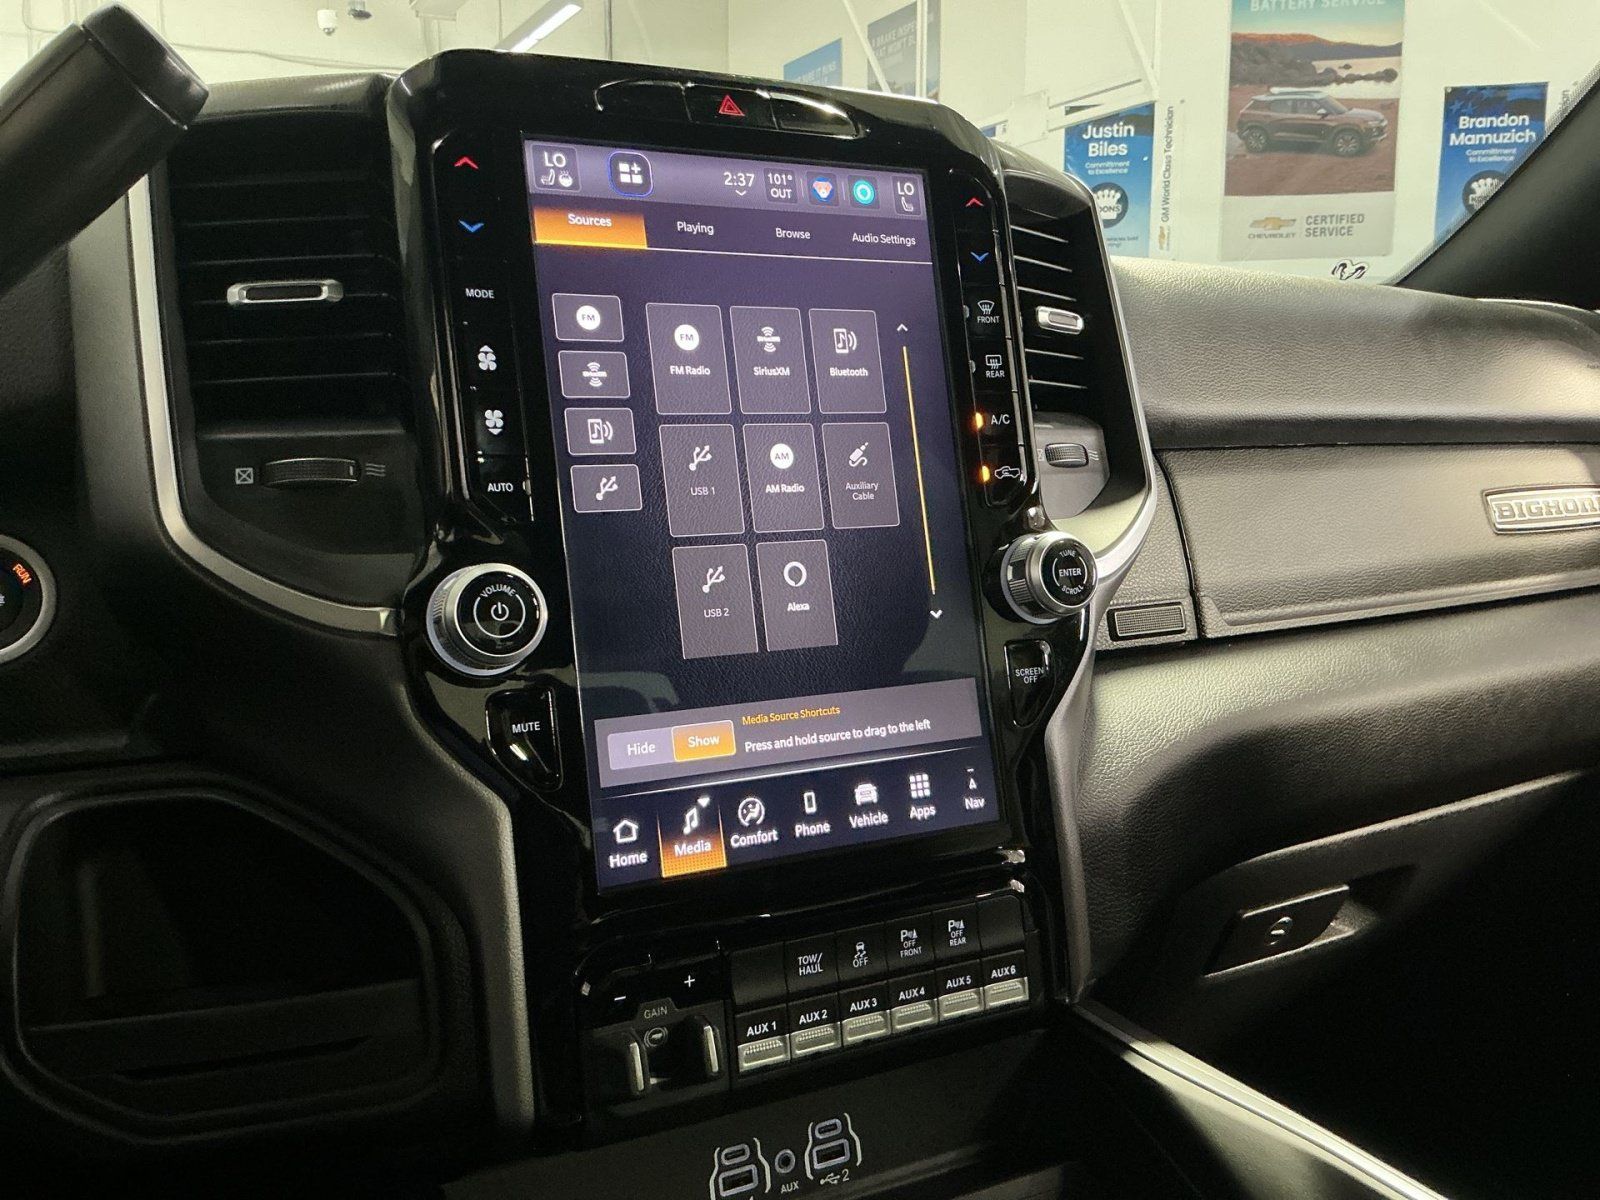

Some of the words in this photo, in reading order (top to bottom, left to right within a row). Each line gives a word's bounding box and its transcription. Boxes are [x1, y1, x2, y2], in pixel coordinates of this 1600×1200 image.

[1250, 0, 1316, 12] BATTERY
[1459, 112, 1530, 129] Brandon
[1082, 121, 1135, 139] Justin
[1164, 106, 1174, 153] Technician
[1449, 129, 1537, 146] Mamuzich
[1088, 141, 1128, 157] Biles
[1465, 148, 1517, 156] Commitment
[543, 152, 567, 168] LO
[1085, 161, 1130, 169] Commitment
[1163, 155, 1172, 180] Class
[723, 171, 755, 188] 2:37
[770, 187, 792, 199] OUT
[897, 181, 915, 196] LO
[1161, 180, 1170, 205] World
[1160, 204, 1169, 223] GM
[1305, 213, 1365, 226] CERTIFIED
[567, 213, 613, 228] Sources
[676, 220, 714, 236] Playing
[775, 227, 811, 240] Browse
[1304, 225, 1354, 238] SERVICE
[851, 232, 878, 244] Audio
[879, 234, 916, 247] Settings
[465, 287, 495, 300] MODE
[581, 313, 596, 322] FM
[977, 315, 1000, 324] FRONT
[679, 335, 695, 343] FM
[669, 365, 684, 375] FM
[685, 365, 711, 376] Radio
[753, 366, 791, 377] SiriusXM
[829, 367, 868, 377] Bluetooth
[985, 370, 1005, 379] REAR
[990, 414, 1011, 425] A/C
[773, 450, 791, 461] AM
[487, 482, 514, 494] AUTO
[690, 486, 709, 496] USB
[710, 486, 716, 495] 1
[765, 484, 780, 494] AM
[781, 483, 805, 493] Radio
[845, 481, 879, 492] Auxiliary
[852, 491, 875, 500] Cable
[1493, 495, 1600, 521] BIGHOR
[1059, 549, 1077, 558] TUNE
[12, 563, 32, 585] RUN
[1058, 567, 1082, 578] ENTER
[479, 583, 517, 599] VOLUME
[1061, 584, 1085, 596] SCROLL
[703, 608, 722, 618] USB
[723, 607, 730, 617] 2
[786, 601, 810, 612] Alexa
[1015, 666, 1044, 678] SCREEN
[1023, 676, 1038, 684] OFF
[742, 713, 769, 725] Media
[769, 711, 799, 722] Source
[799, 706, 841, 718] Shortcuts
[511, 721, 541, 734] MUTE
[744, 740, 773, 753] Press
[773, 736, 794, 750] and
[794, 732, 818, 746] hold
[818, 730, 851, 743] source
[852, 728, 863, 739] to
[863, 725, 887, 738] drag
[887, 723, 899, 734] to
[898, 721, 915, 733] the
[915, 718, 931, 730] left
[626, 741, 656, 757] Hide
[687, 732, 721, 749] Show
[964, 796, 986, 811] Nav
[849, 811, 889, 828] Vehicle
[909, 804, 937, 822] Apps
[794, 819, 831, 838] Phone
[730, 828, 779, 849] Comfort
[673, 839, 712, 857] Media
[609, 850, 649, 868] Home
[950, 929, 963, 939] OFF
[903, 939, 916, 949] OFF
[949, 936, 967, 947] REAR
[798, 952, 823, 965] TOW/
[900, 946, 922, 958] FRONT
[852, 957, 869, 968] OFF
[799, 963, 824, 976] HAUL
[991, 967, 1009, 979] AUX
[1008, 964, 1016, 976] 6
[946, 977, 965, 989] AUX
[964, 975, 972, 985] 5
[898, 988, 918, 1001] AUX
[917, 986, 926, 997] 4
[850, 1000, 871, 1012] AUX
[870, 997, 878, 1008] 3
[643, 1005, 668, 1019] GAIN
[799, 1012, 822, 1025] AUX
[821, 1009, 828, 1019] 2
[746, 1023, 769, 1037] AUX
[770, 1020, 778, 1031] 1
[842, 1170, 849, 1181] 2
[780, 1181, 799, 1194] AUX
